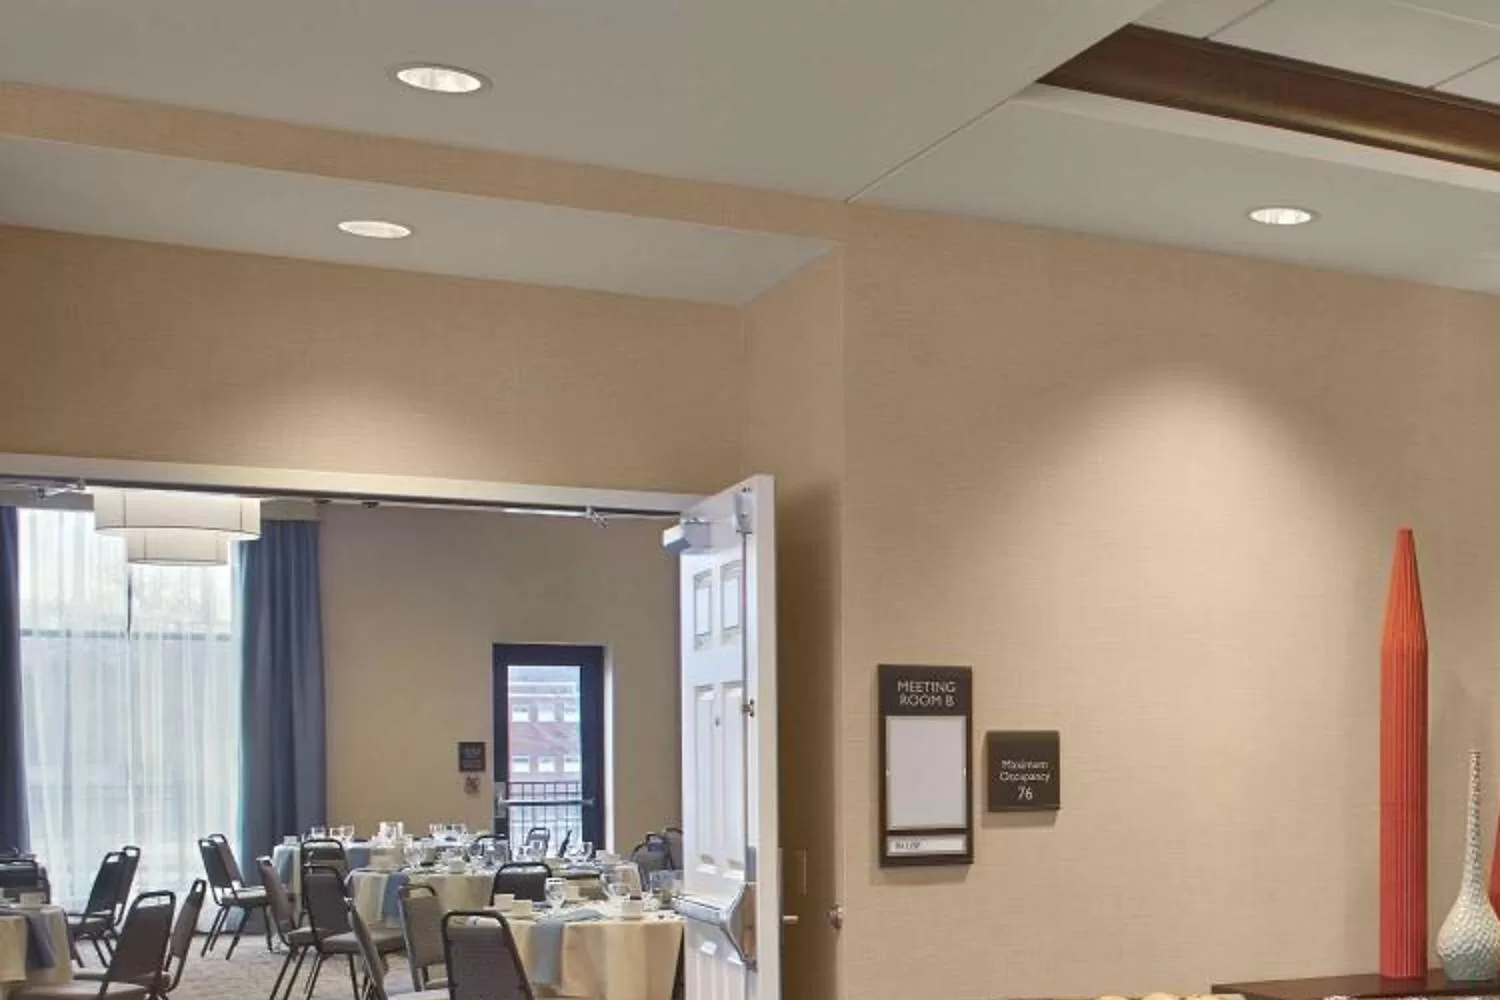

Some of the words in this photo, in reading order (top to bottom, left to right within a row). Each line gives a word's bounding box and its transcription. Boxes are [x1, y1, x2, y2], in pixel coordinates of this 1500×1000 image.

[897, 680, 957, 693] MEETING
[899, 694, 942, 707] ROOM
[945, 694, 956, 708] B
[1001, 759, 1049, 769] Maximum
[999, 771, 1051, 784] Occupancy
[1017, 785, 1033, 800] 76
